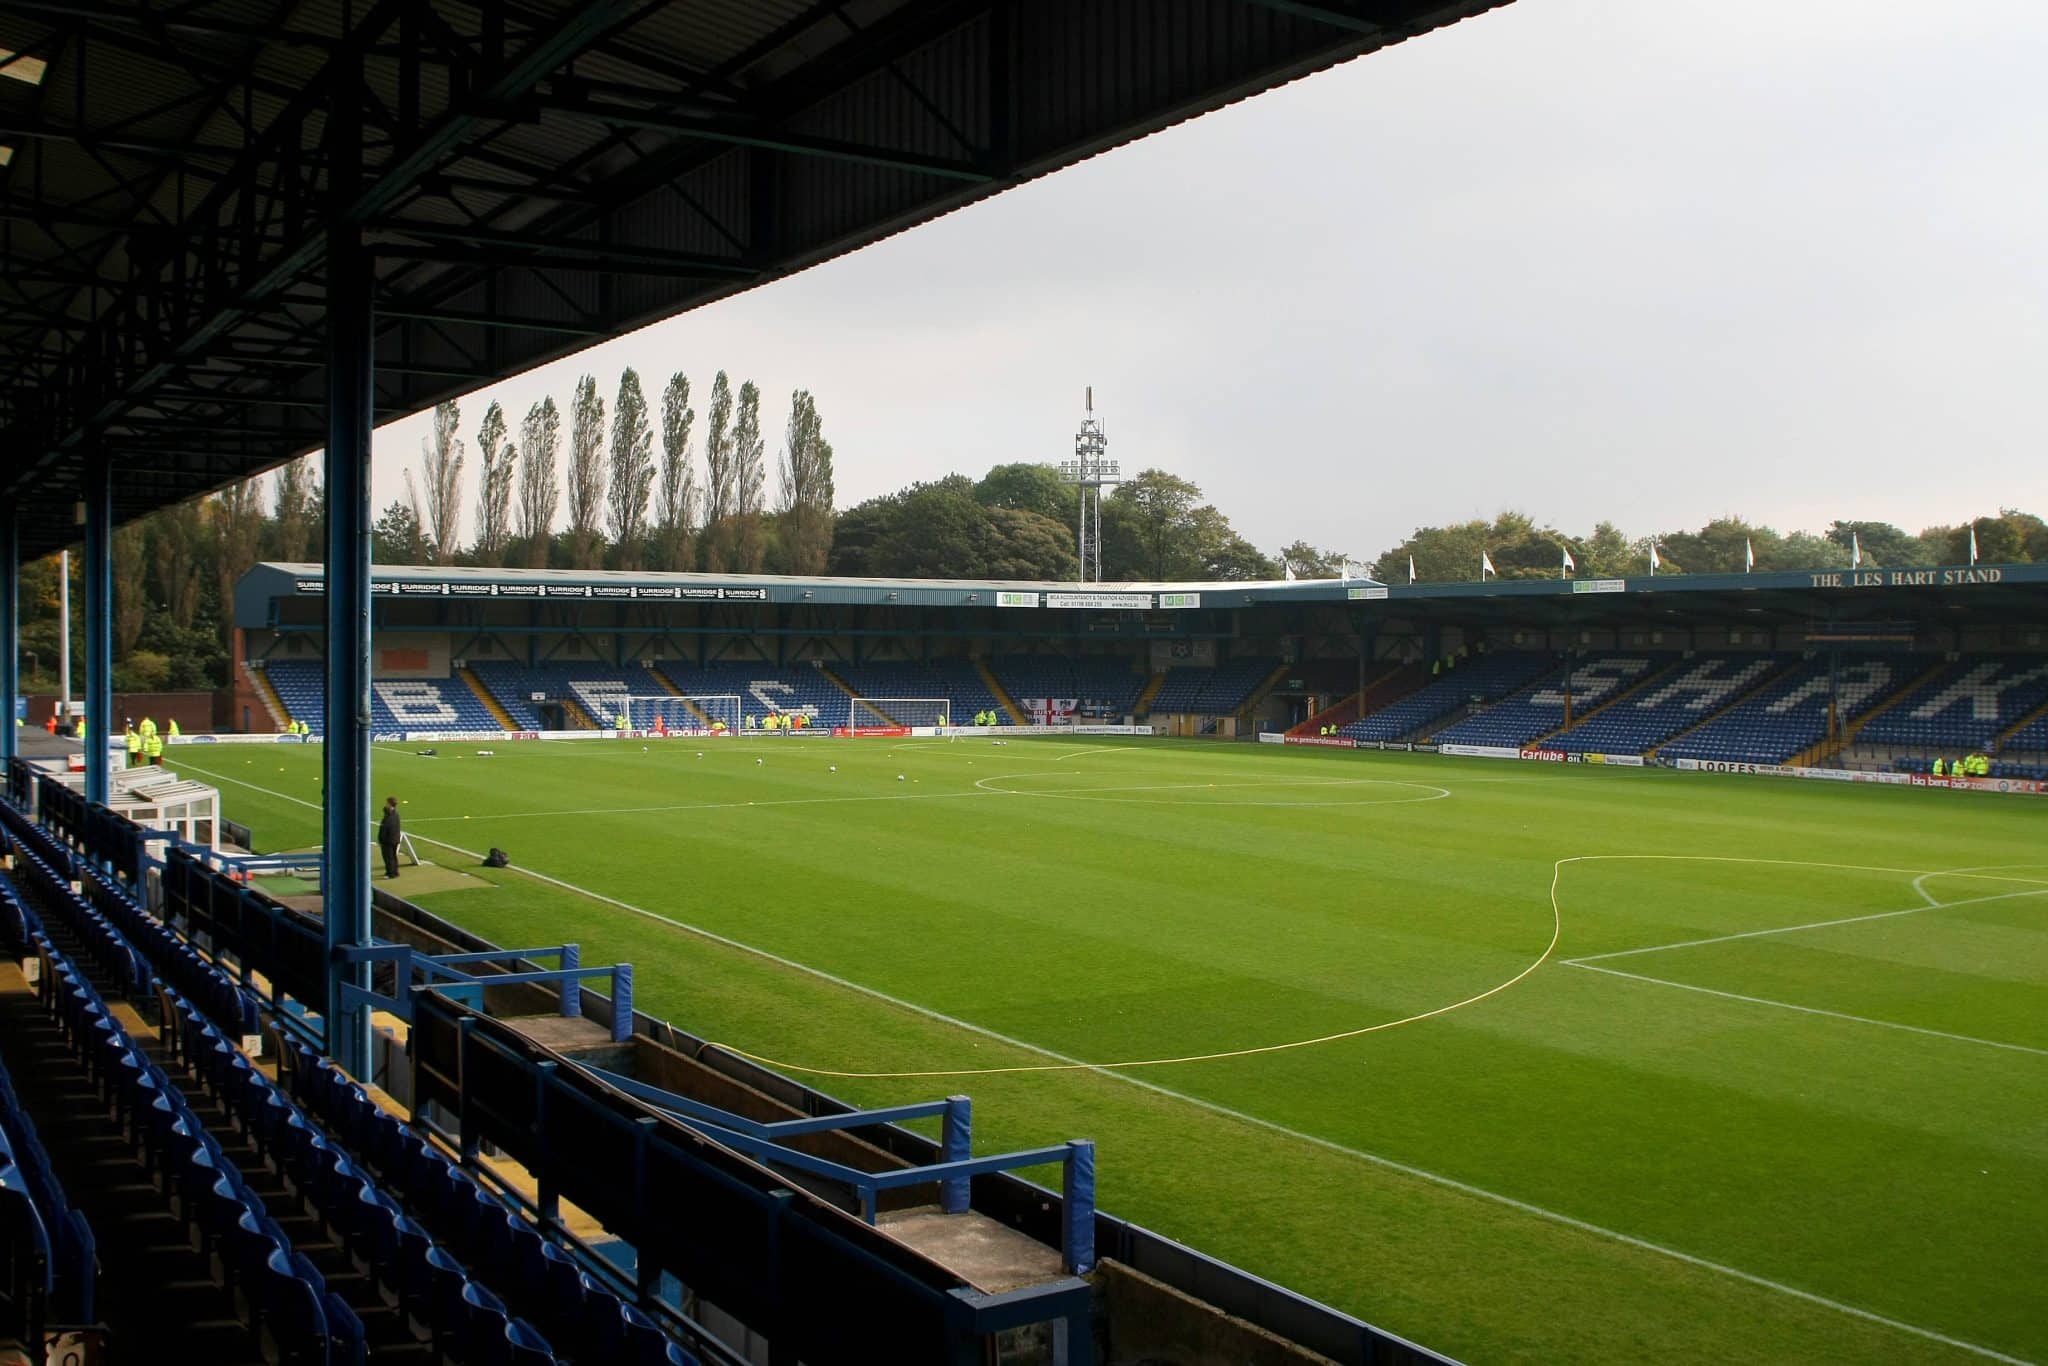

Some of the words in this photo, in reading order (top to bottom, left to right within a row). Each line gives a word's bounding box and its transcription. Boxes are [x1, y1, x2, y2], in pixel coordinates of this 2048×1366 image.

[1810, 574, 1842, 587] THE
[1853, 573, 1882, 586] LES
[1891, 571, 1937, 585] HART
[1943, 569, 2001, 584] STAND
[1521, 749, 1564, 762] Carlube
